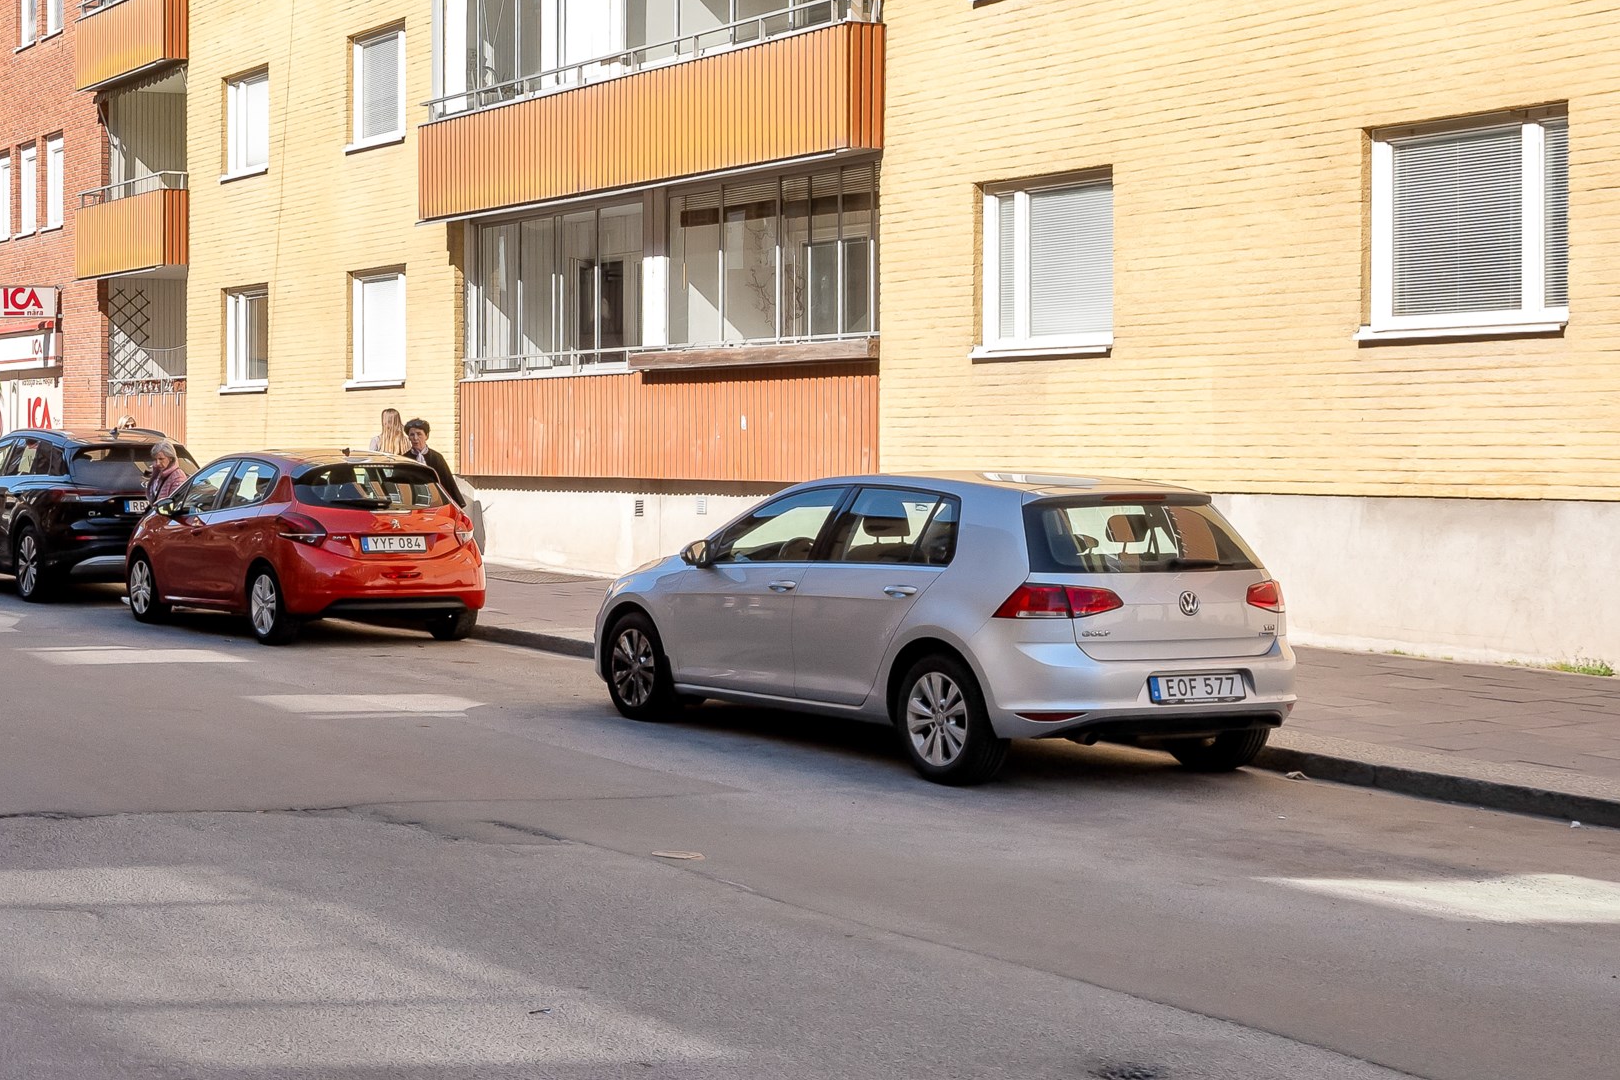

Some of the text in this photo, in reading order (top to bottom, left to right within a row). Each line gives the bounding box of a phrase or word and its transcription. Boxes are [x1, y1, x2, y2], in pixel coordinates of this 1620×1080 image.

[3, 287, 44, 309] ICA
[32, 338, 43, 355] ICA
[28, 396, 52, 429] ICA
[371, 537, 421, 549] YYF 084
[1166, 677, 1235, 697] EOF 577
